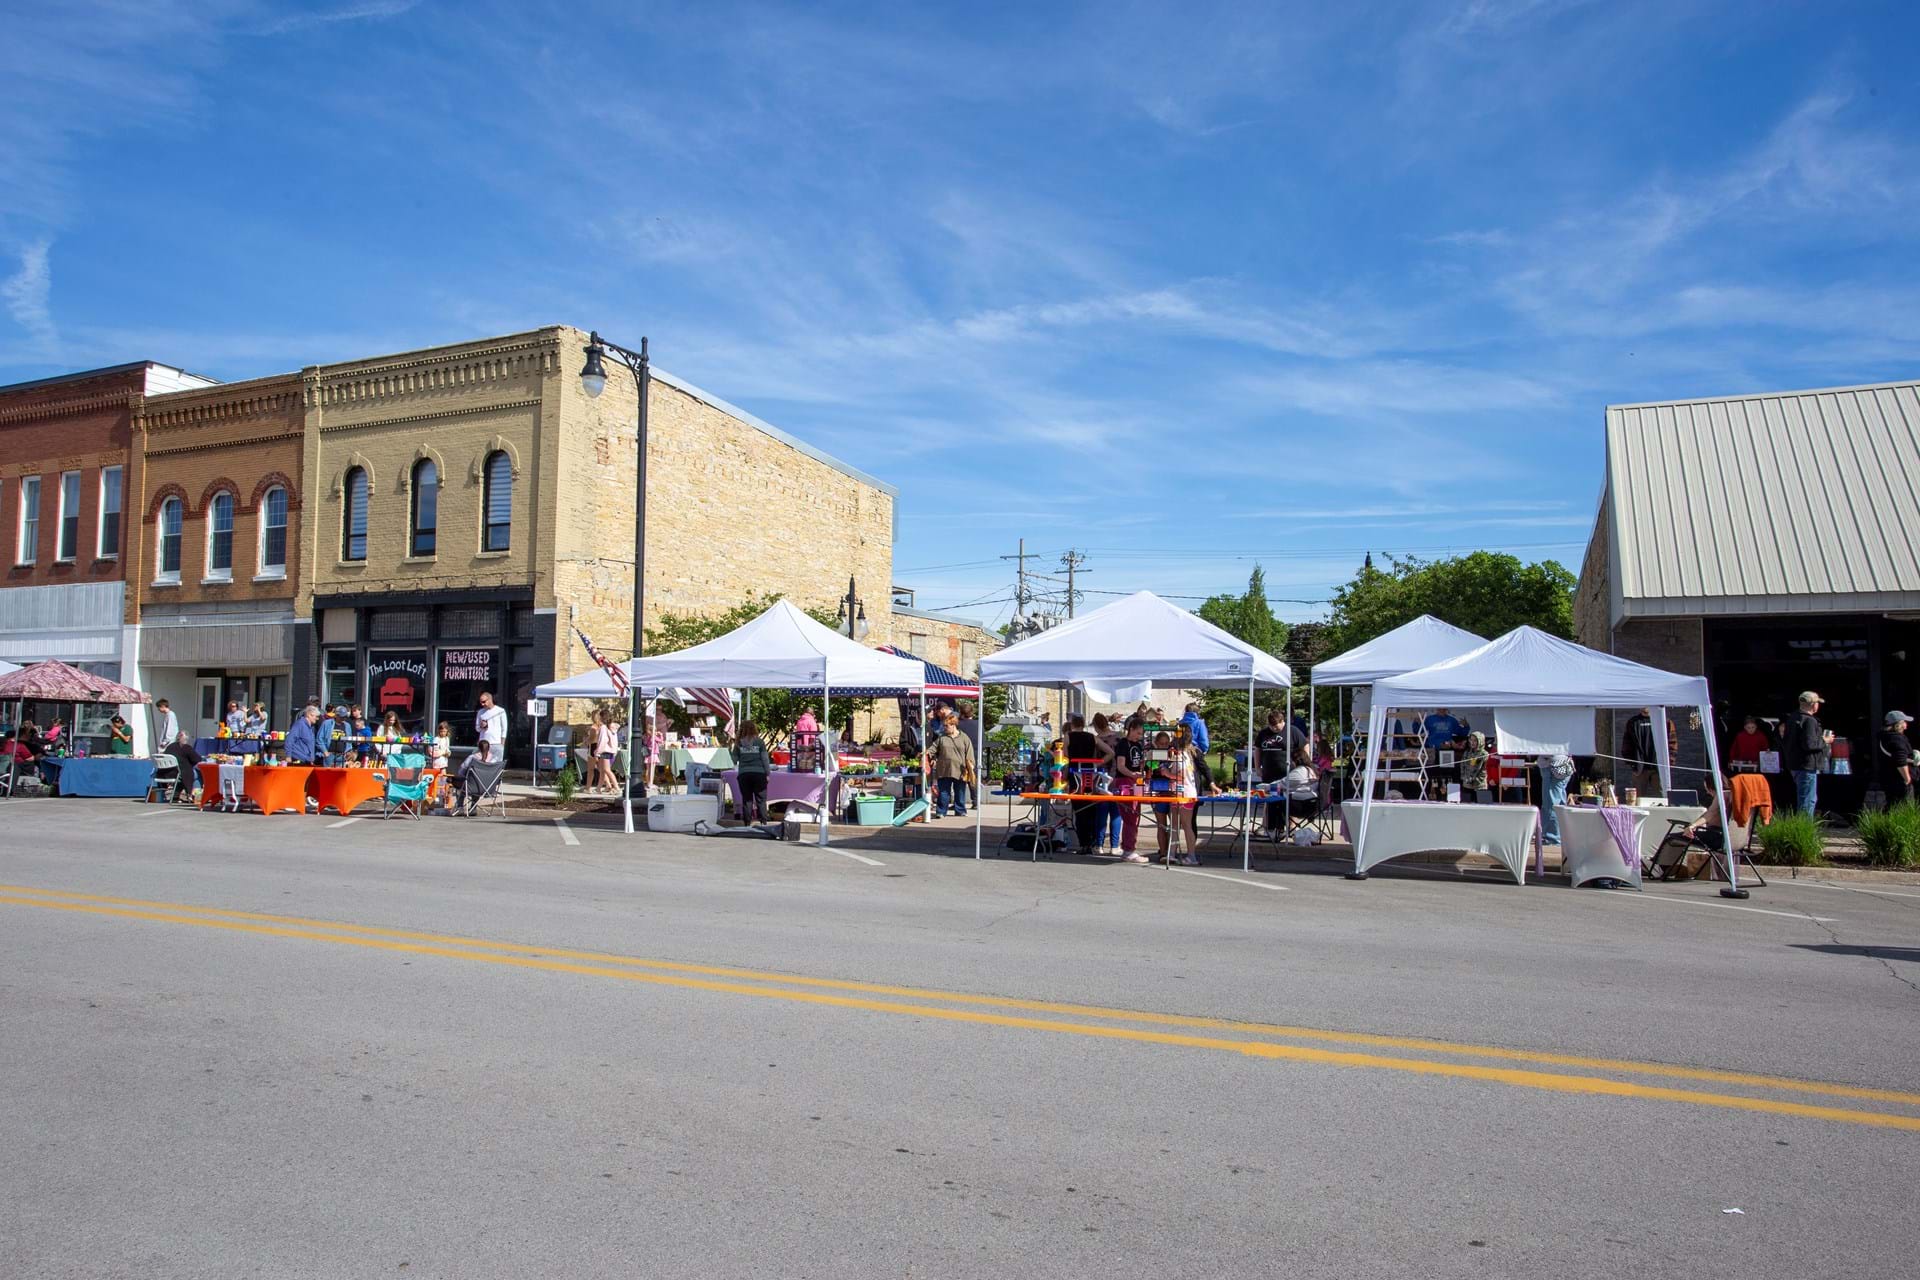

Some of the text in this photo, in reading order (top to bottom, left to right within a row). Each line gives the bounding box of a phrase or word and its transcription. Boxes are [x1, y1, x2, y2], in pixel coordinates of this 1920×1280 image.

[445, 651, 490, 664] NEW/USED
[369, 663, 383, 676] The
[444, 666, 490, 681] FURNITURE
